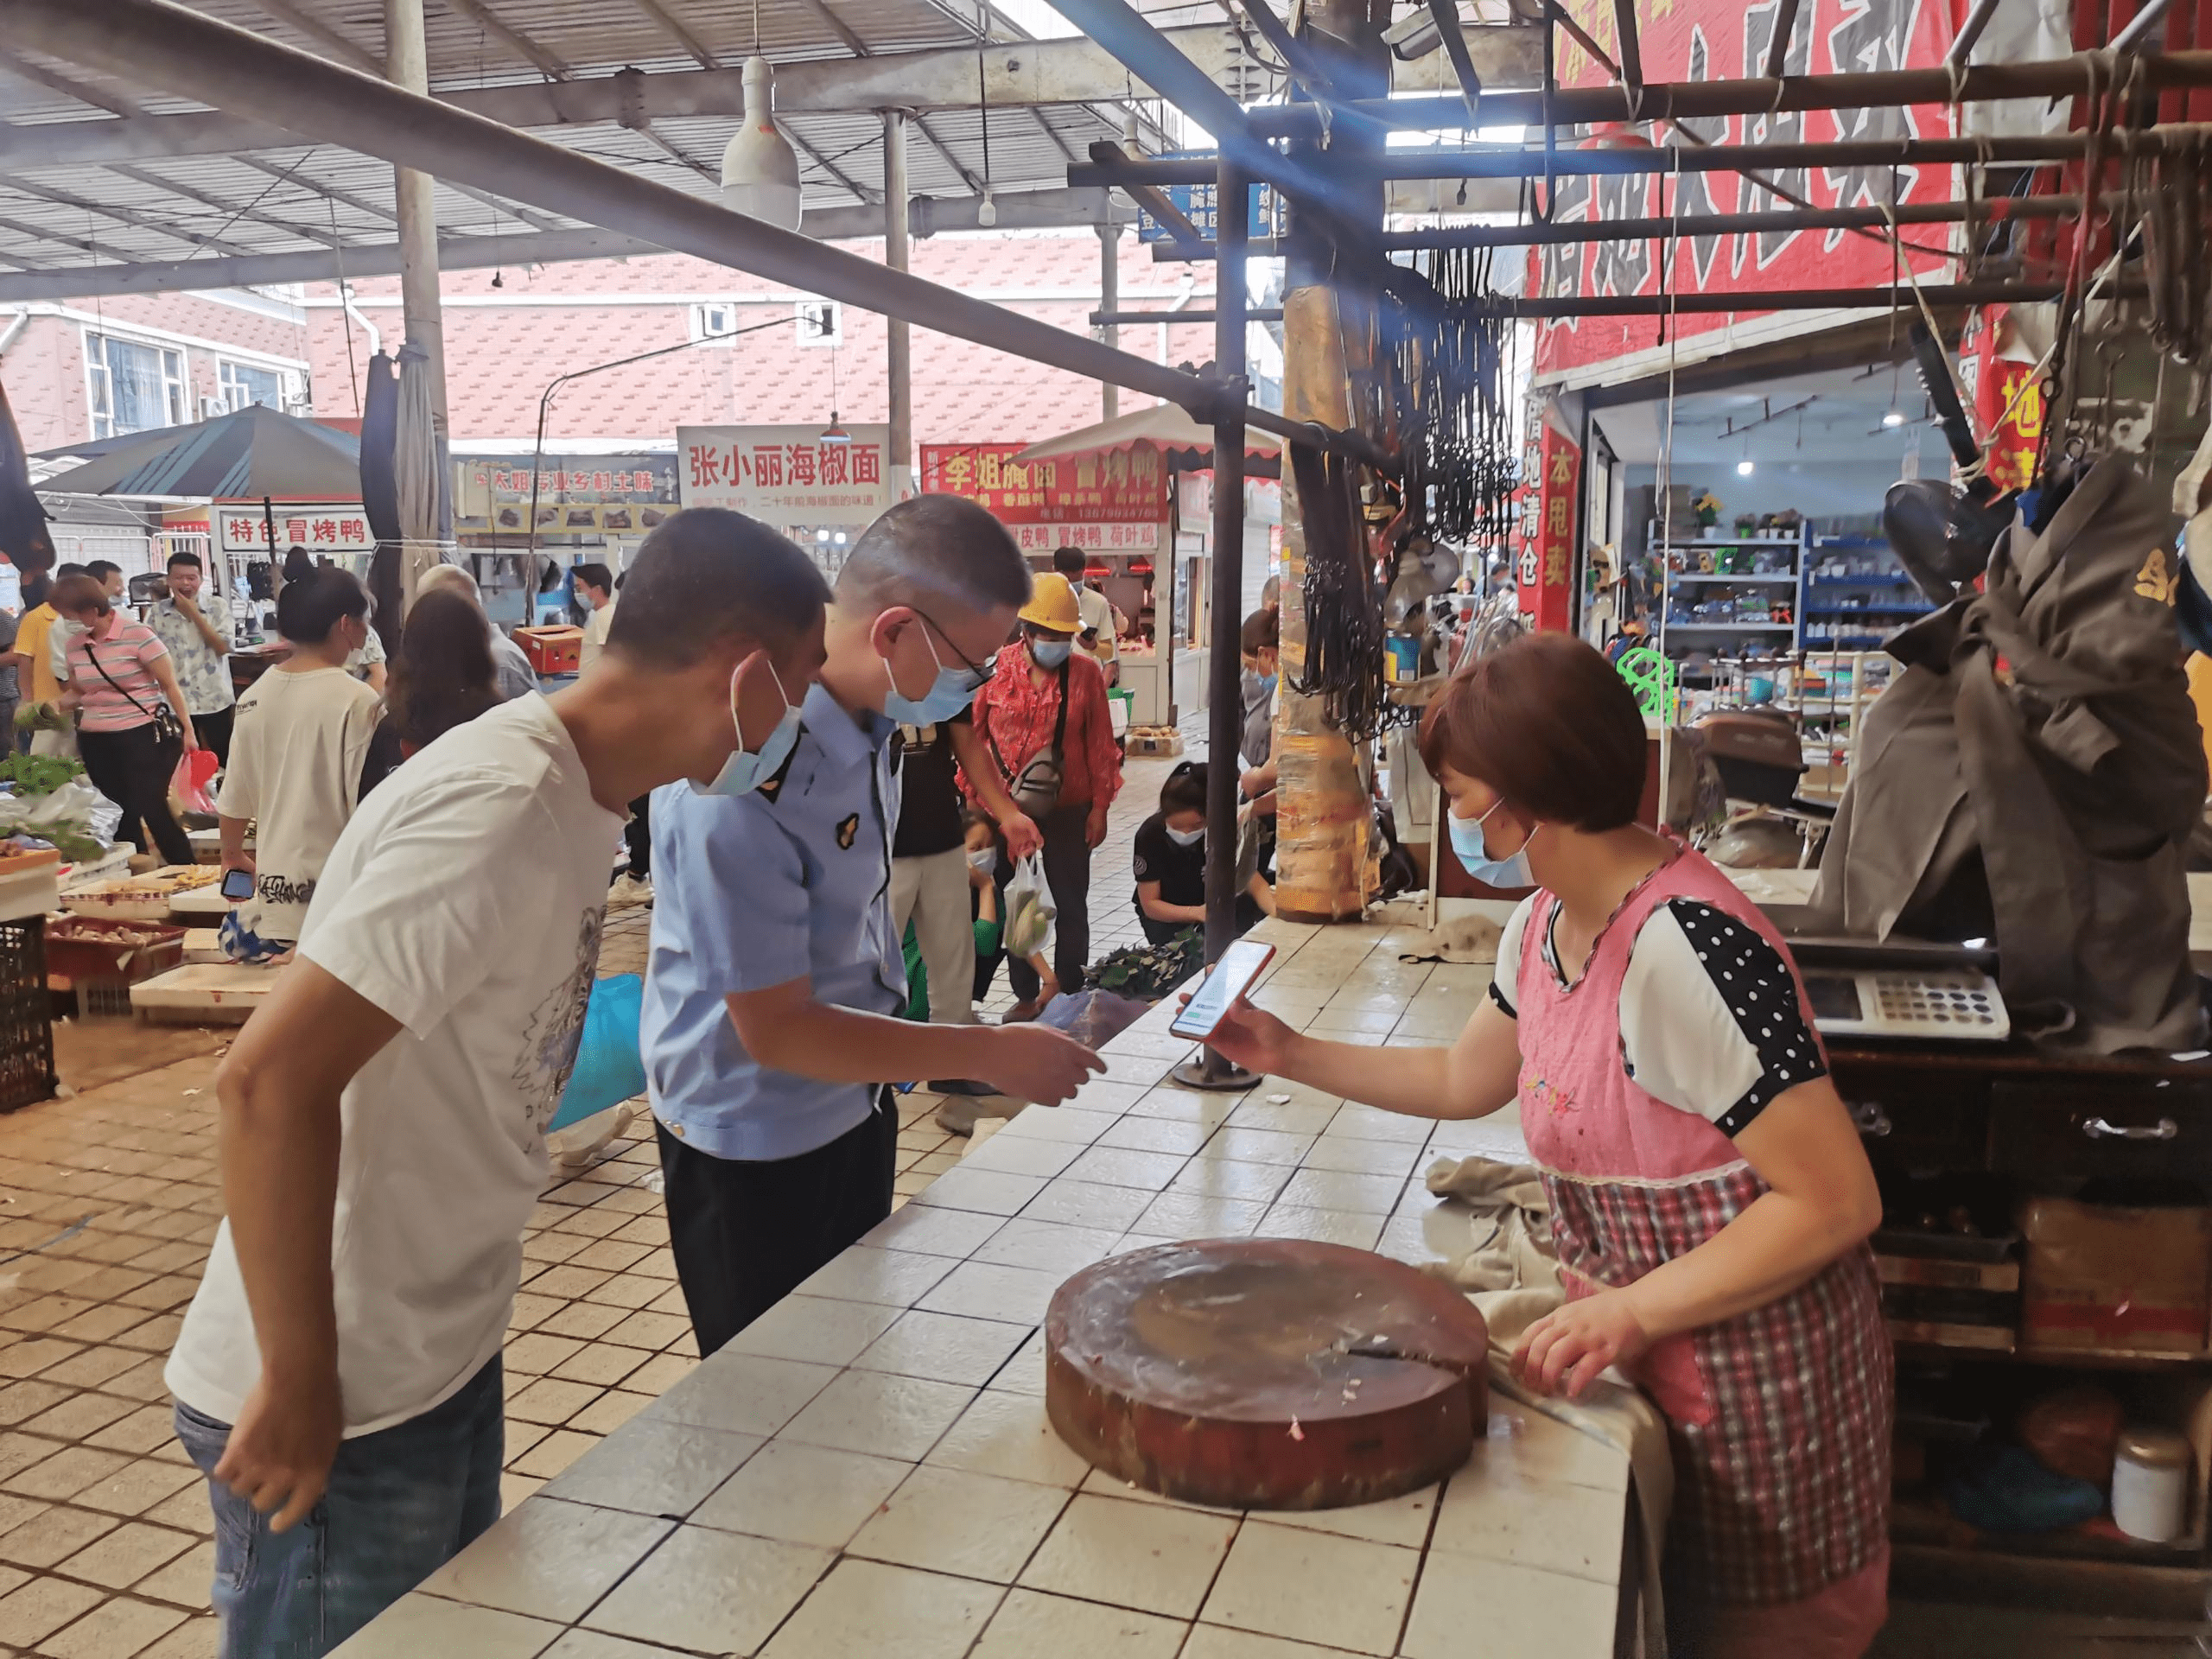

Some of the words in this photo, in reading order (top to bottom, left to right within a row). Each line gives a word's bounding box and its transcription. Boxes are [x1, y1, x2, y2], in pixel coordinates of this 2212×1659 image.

[690, 443, 880, 487] 张小丽海椒面
[474, 470, 654, 493] 大姐专业乡村土味
[1544, 446, 1574, 587] 本甩卖
[230, 518, 365, 544] 特色冒烤鸭
[1109, 524, 1155, 547] 荷叶鸡
